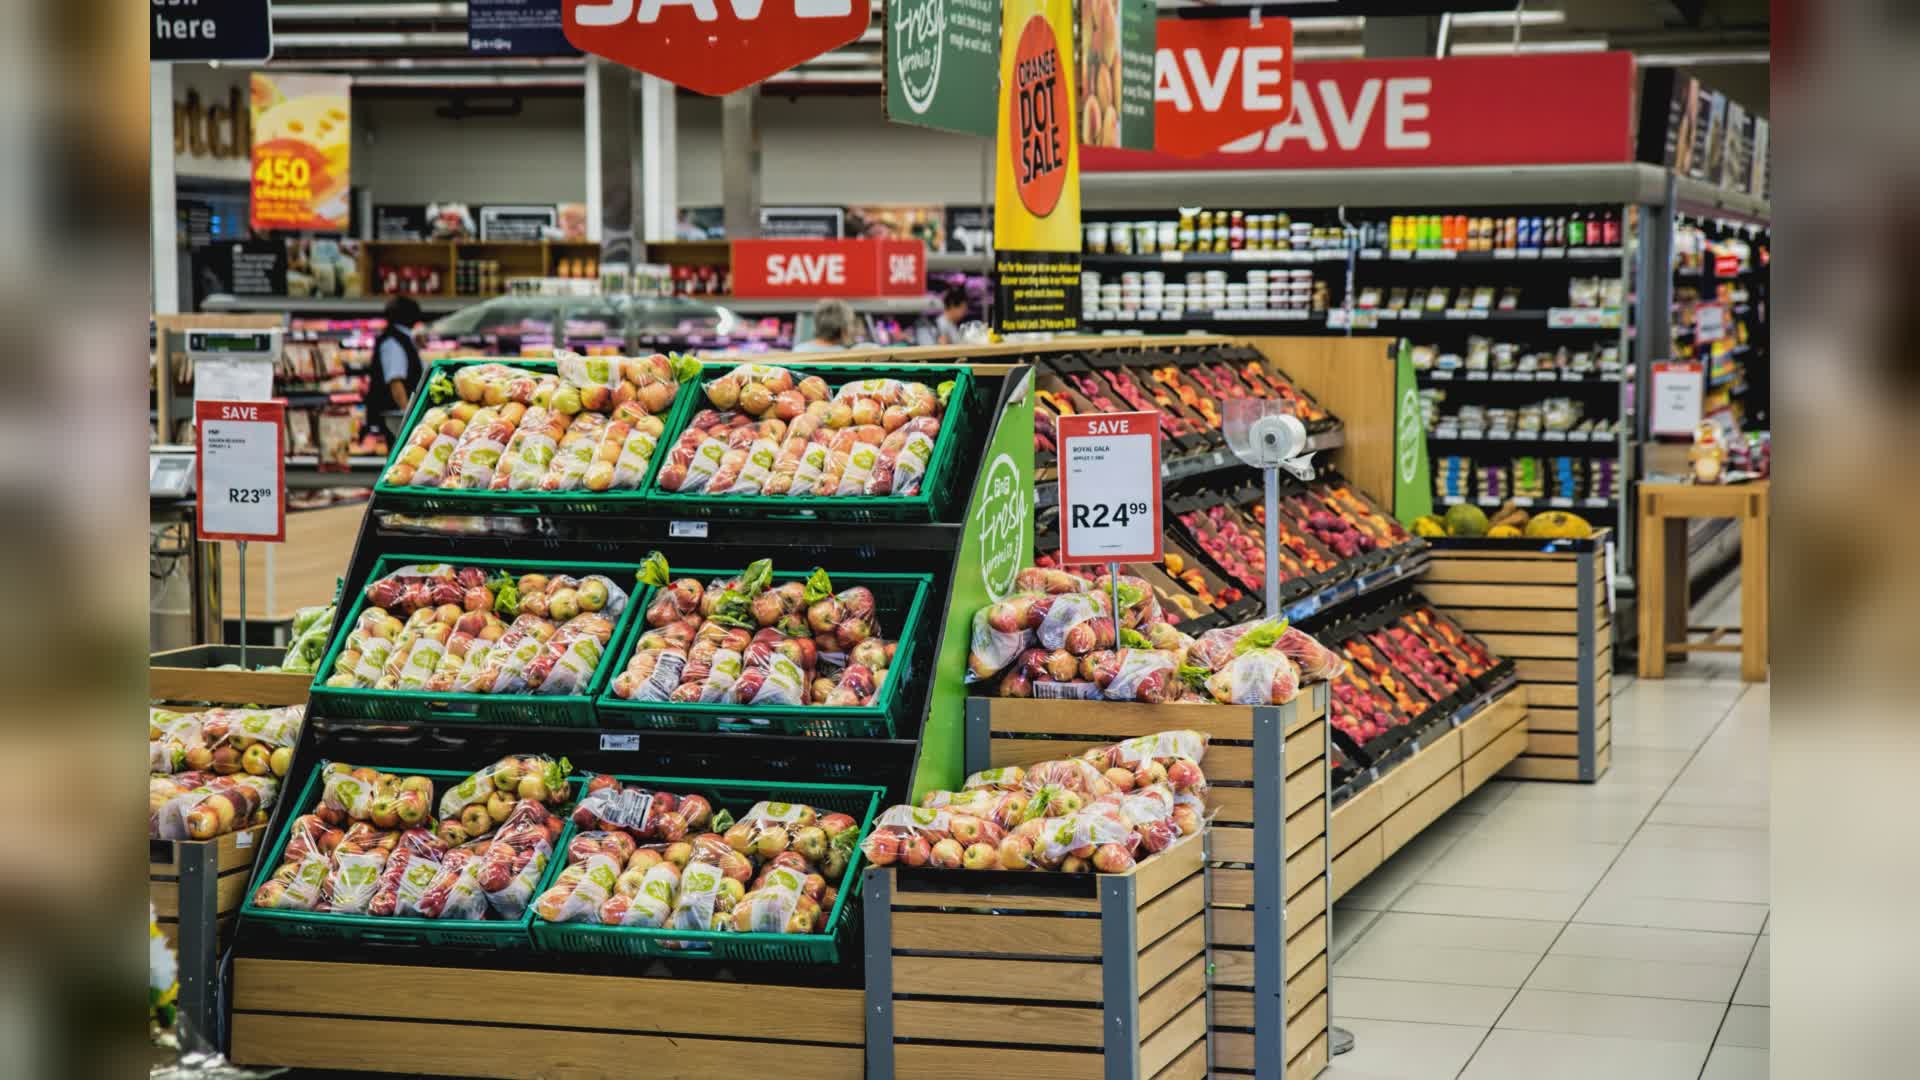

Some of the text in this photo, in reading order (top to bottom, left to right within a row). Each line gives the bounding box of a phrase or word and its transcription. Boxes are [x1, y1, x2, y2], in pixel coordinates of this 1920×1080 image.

[156, 14, 217, 39] here
[1018, 48, 1056, 88] ORANGE
[1155, 46, 1284, 112] AVE
[1019, 76, 1056, 139] DOT
[1218, 77, 1432, 152] AVE
[255, 157, 311, 188] 450
[1022, 126, 1063, 184] SALE
[766, 254, 846, 285] SAVE
[222, 406, 258, 420] SAVE
[1088, 420, 1129, 434] SAVE
[976, 490, 1028, 551] Fresh
